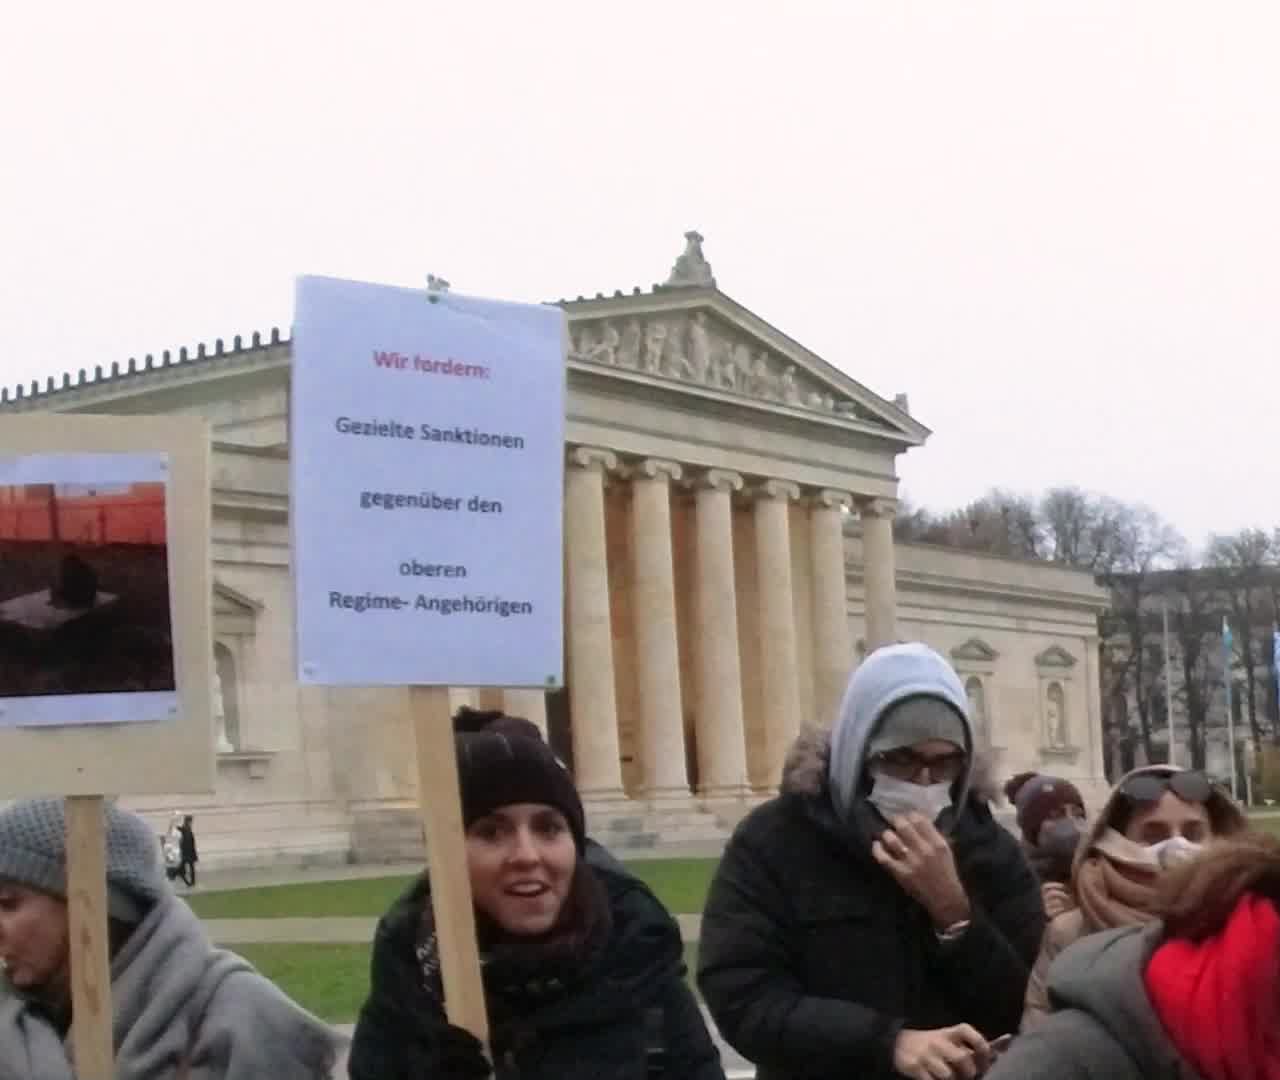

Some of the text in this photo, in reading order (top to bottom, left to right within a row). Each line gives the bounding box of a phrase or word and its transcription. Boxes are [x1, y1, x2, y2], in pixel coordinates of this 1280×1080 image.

[373, 351, 491, 379] Wir fordern:
[335, 416, 525, 450] Gezielte Sanktionen
[359, 490, 503, 513] gegenüber den
[398, 559, 468, 578] oberen
[328, 591, 533, 617] Regime- Angehörigen
